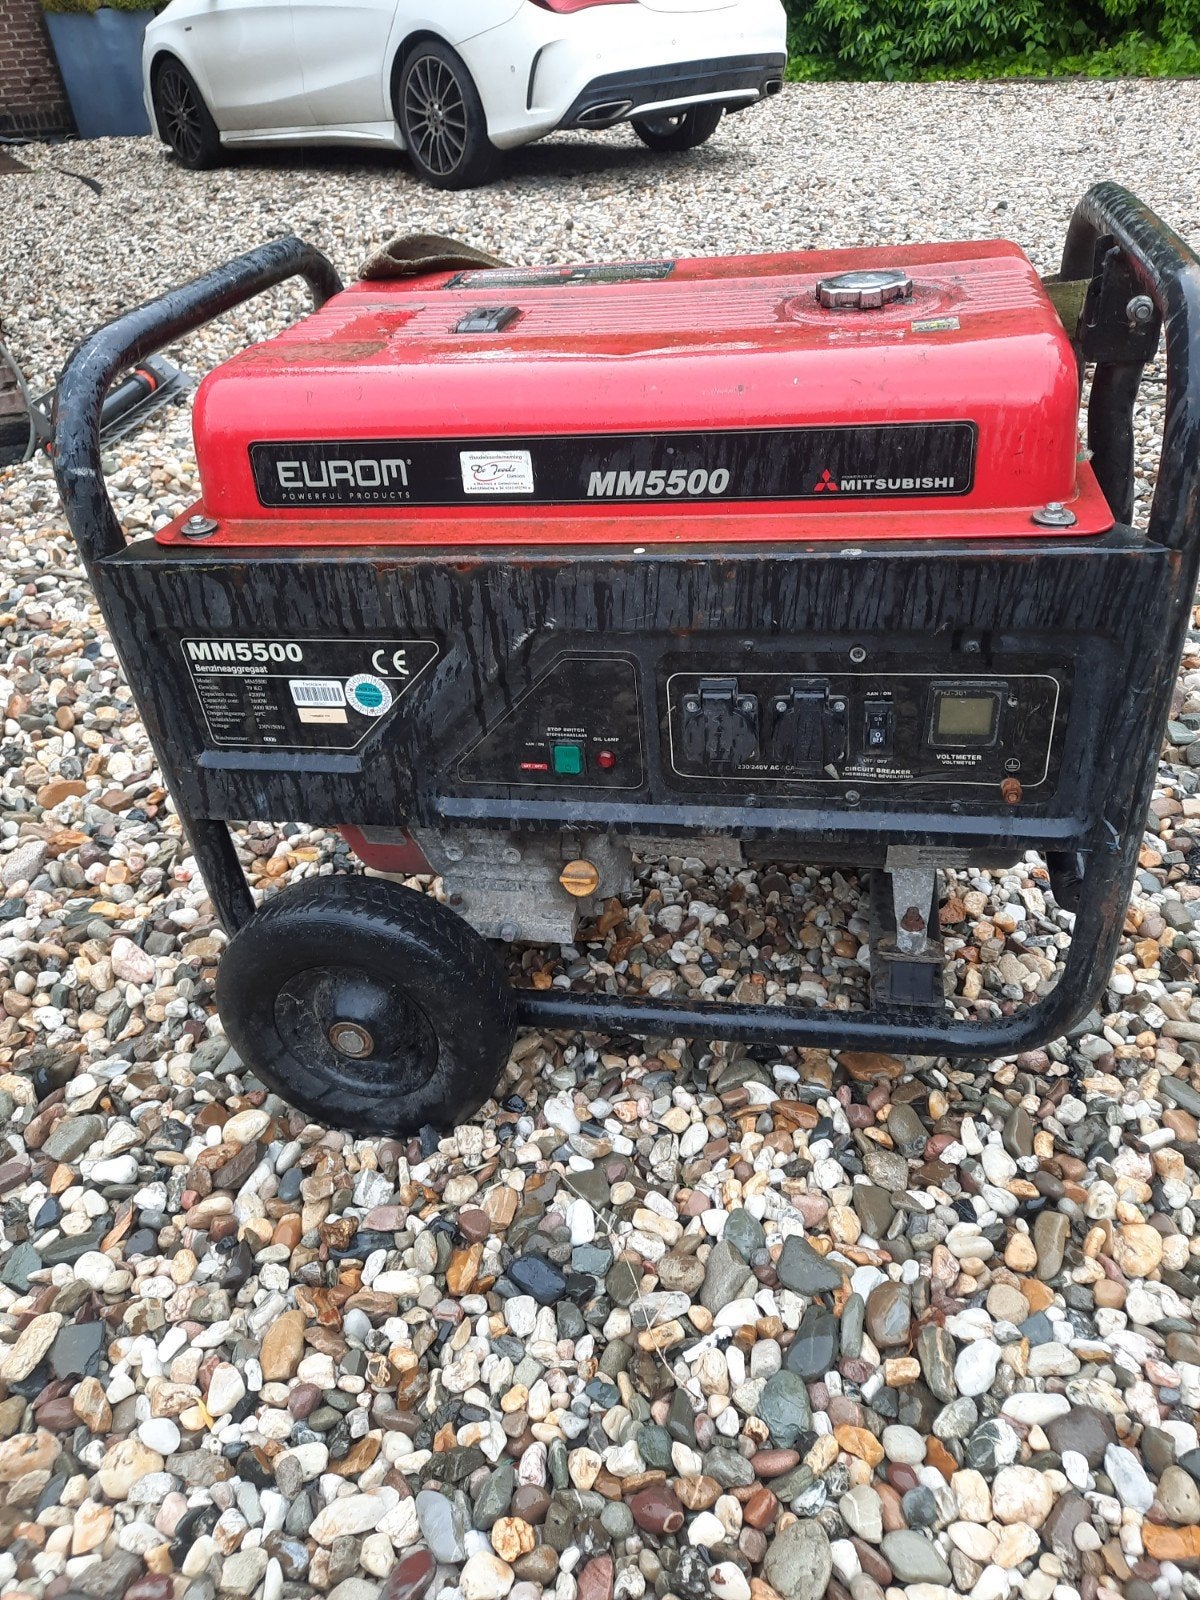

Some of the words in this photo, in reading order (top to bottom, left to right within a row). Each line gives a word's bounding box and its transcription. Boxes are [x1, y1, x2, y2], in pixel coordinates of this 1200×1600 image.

[276, 459, 409, 487] EUROM
[587, 468, 730, 496] MM5500
[841, 477, 955, 491] MITSUBISHI
[282, 492, 342, 500] POWERFUL
[350, 491, 410, 499] PRODUCTS
[186, 642, 303, 662] MM5500
[194, 664, 269, 675] Benzineaggregaat
